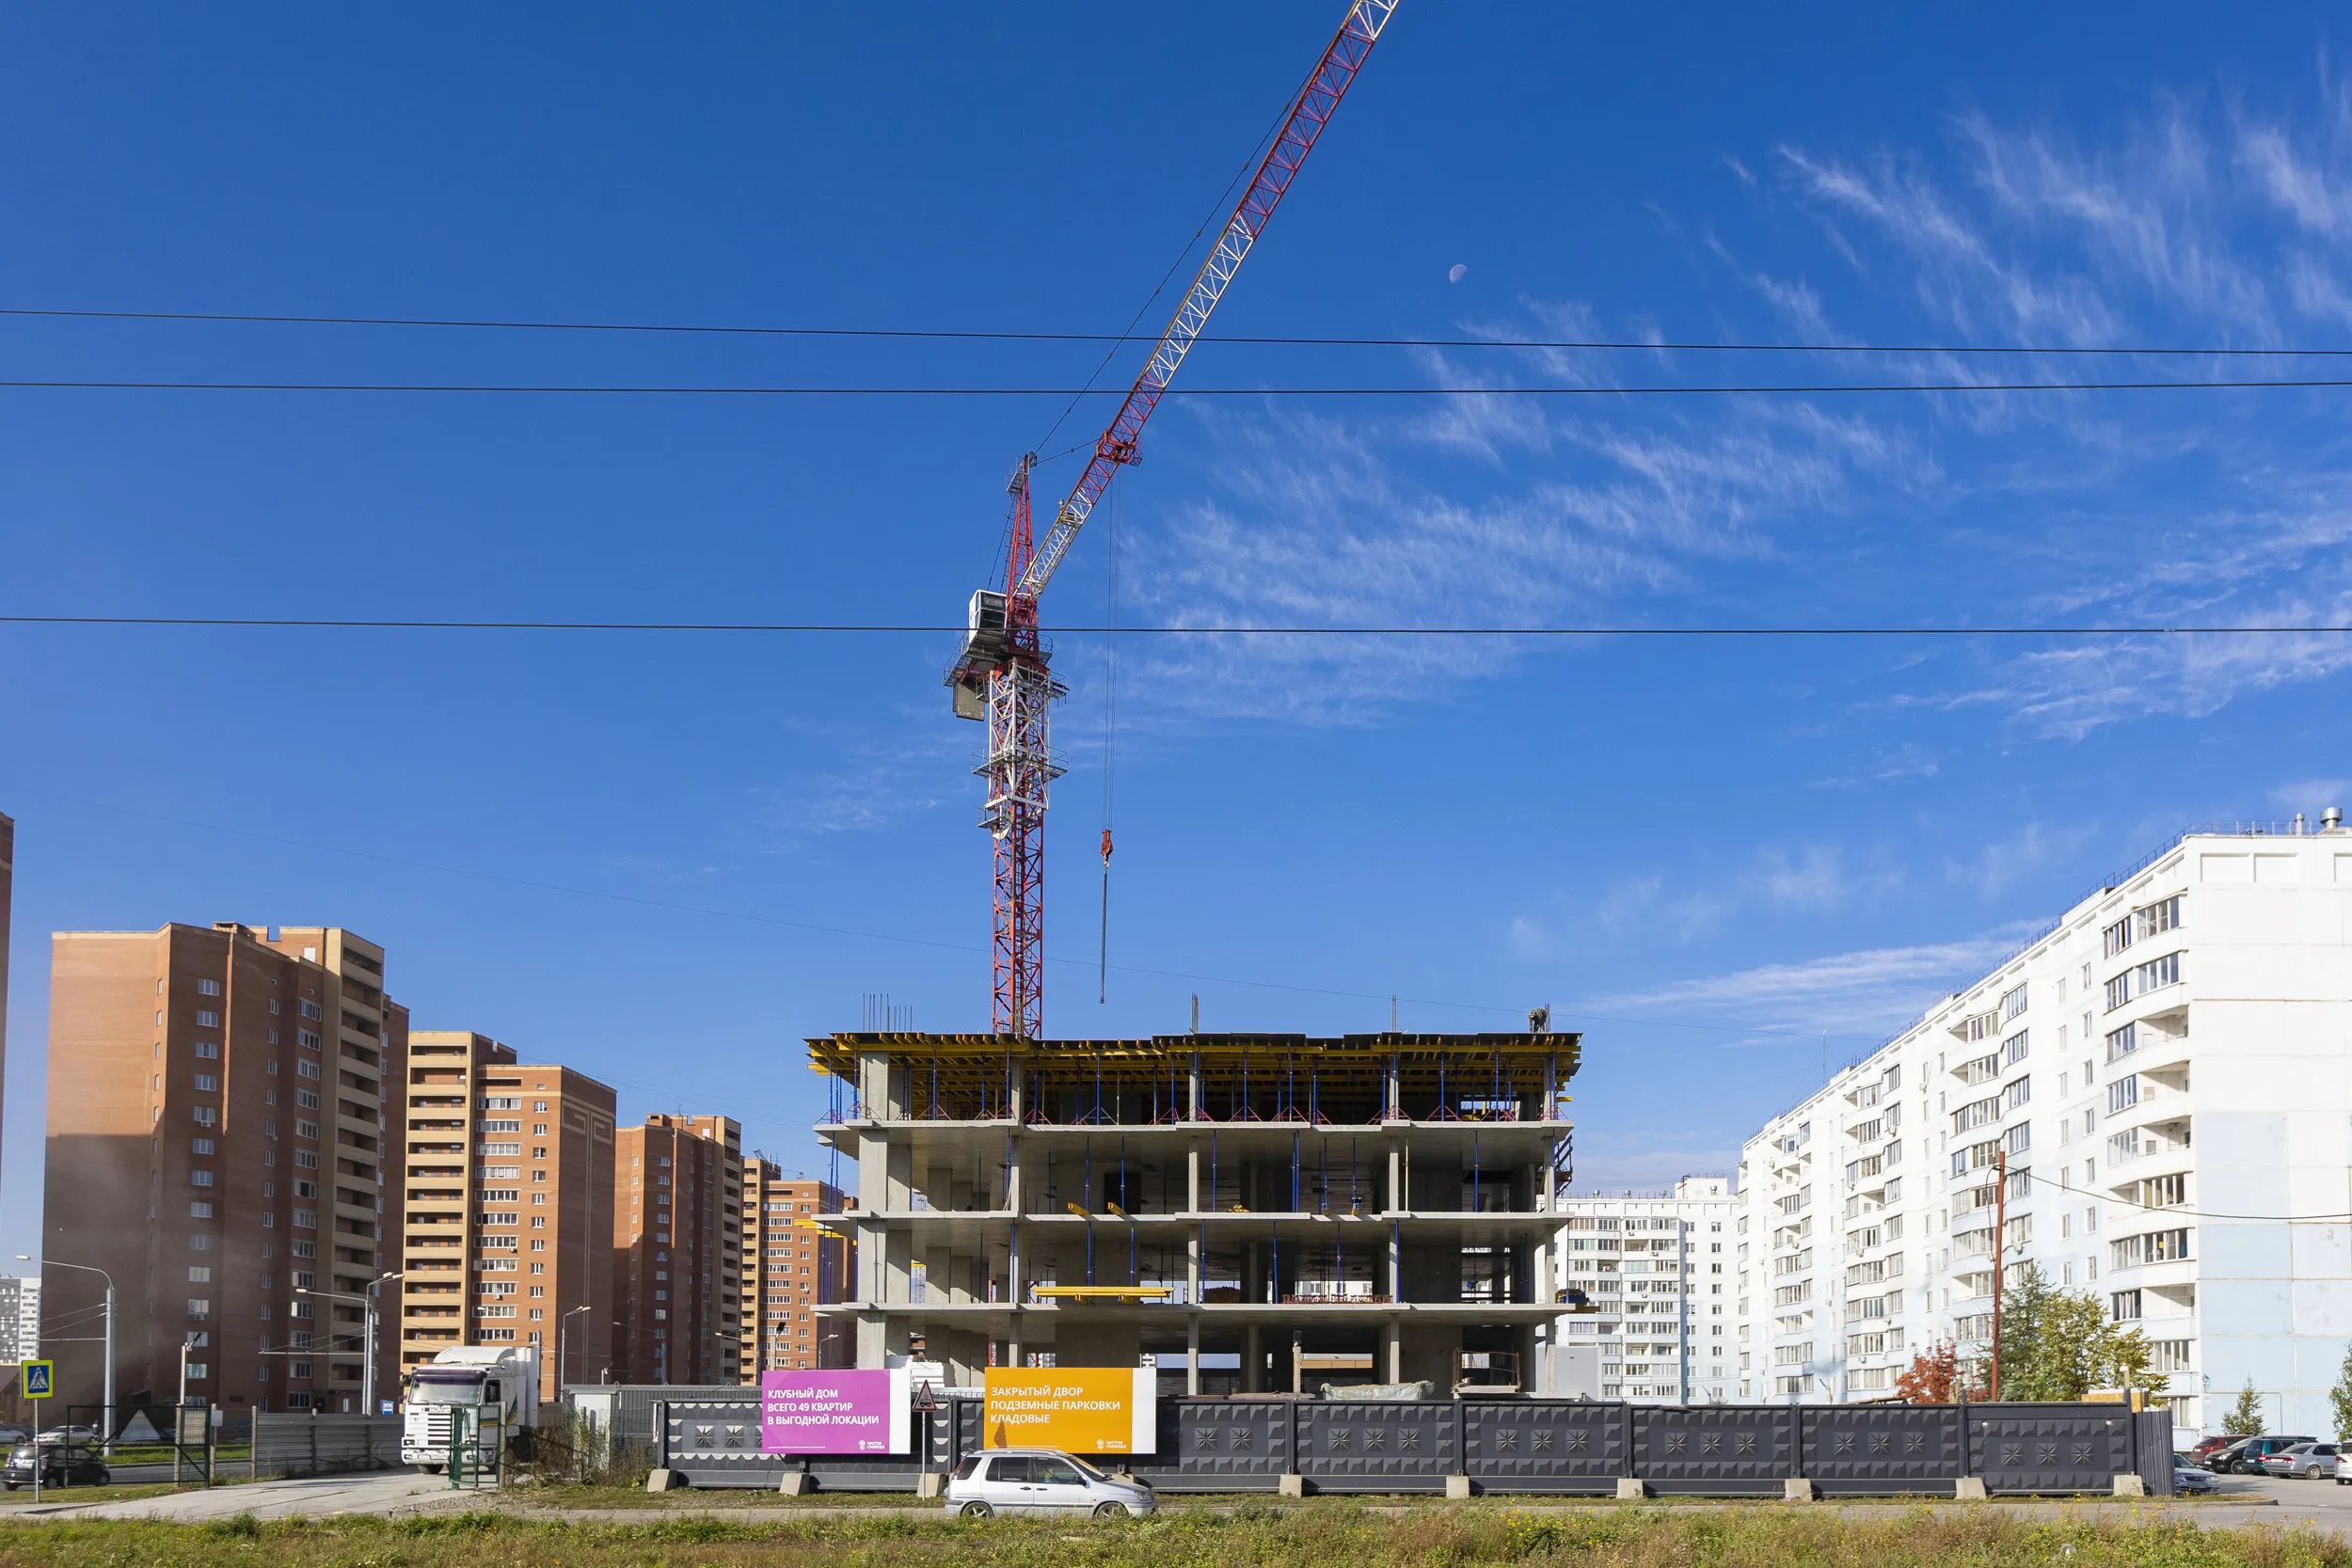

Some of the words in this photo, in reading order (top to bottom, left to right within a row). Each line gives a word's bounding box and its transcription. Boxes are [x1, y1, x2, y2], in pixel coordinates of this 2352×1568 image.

[768, 1387, 814, 1399] КЛУБНЫЙ
[816, 1389, 838, 1400] ДОМ
[991, 1385, 1051, 1396] ЗАКРЫТЫЙ
[1053, 1386, 1084, 1398] ДВОР
[767, 1402, 797, 1412] ВСЕГО
[798, 1402, 809, 1411] 49
[811, 1402, 853, 1412] КВАРТИР
[991, 1401, 1059, 1411] ПОДЗЕМНЫЕ
[1062, 1401, 1120, 1410] ПАРКОВКИ
[767, 1416, 774, 1425] В
[775, 1414, 830, 1426] ВЫГОДНОЙ
[831, 1415, 880, 1426] ЛОКАЦИИ
[990, 1414, 1051, 1425] КЛАДОВЫЕ
